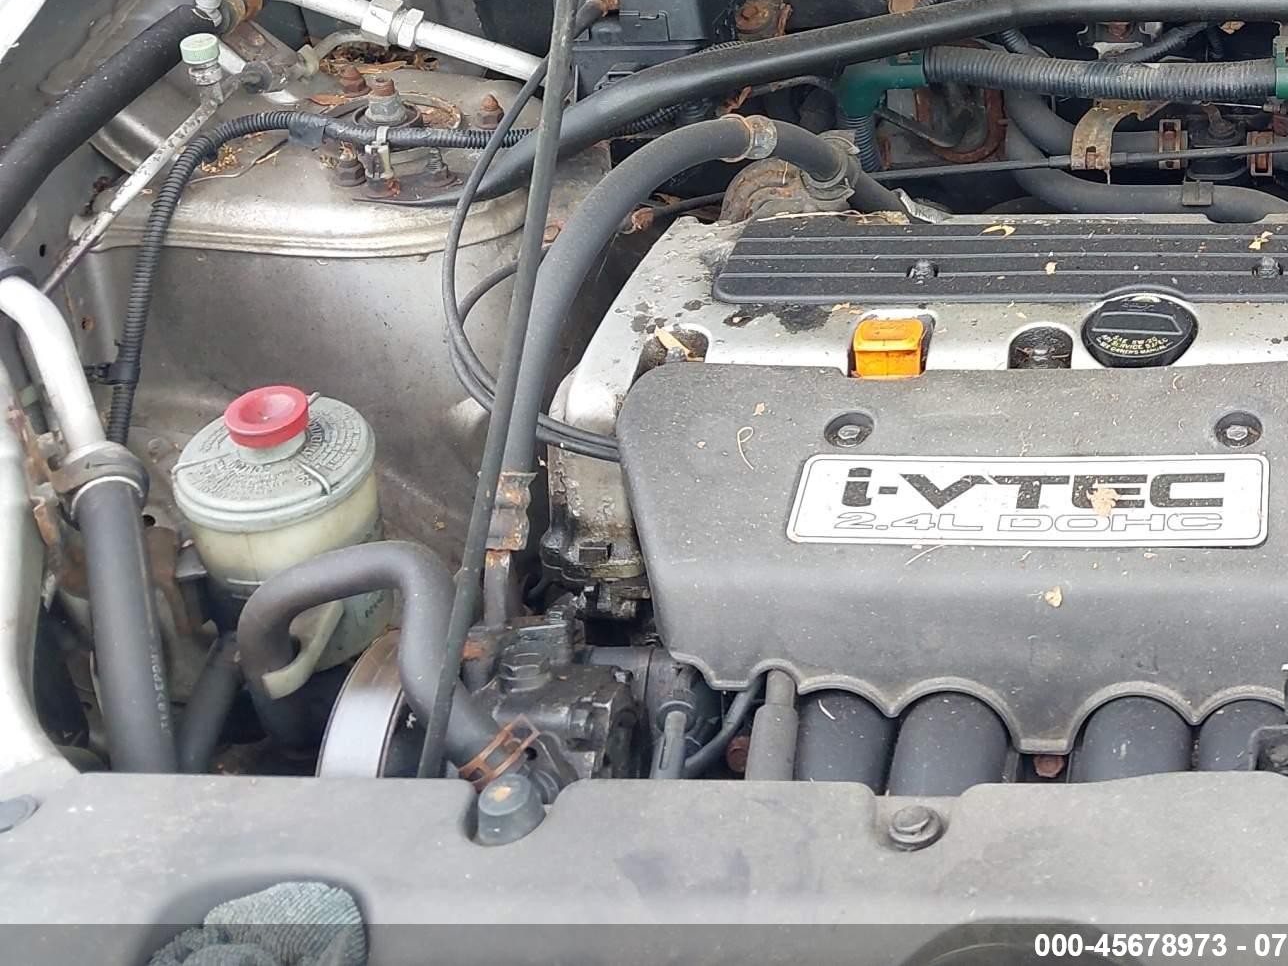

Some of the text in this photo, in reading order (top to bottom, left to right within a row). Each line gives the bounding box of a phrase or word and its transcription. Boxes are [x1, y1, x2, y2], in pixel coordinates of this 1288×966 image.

[841, 467, 1226, 510] i-VTEC
[833, 511, 1223, 533] 2.4L DOHC
